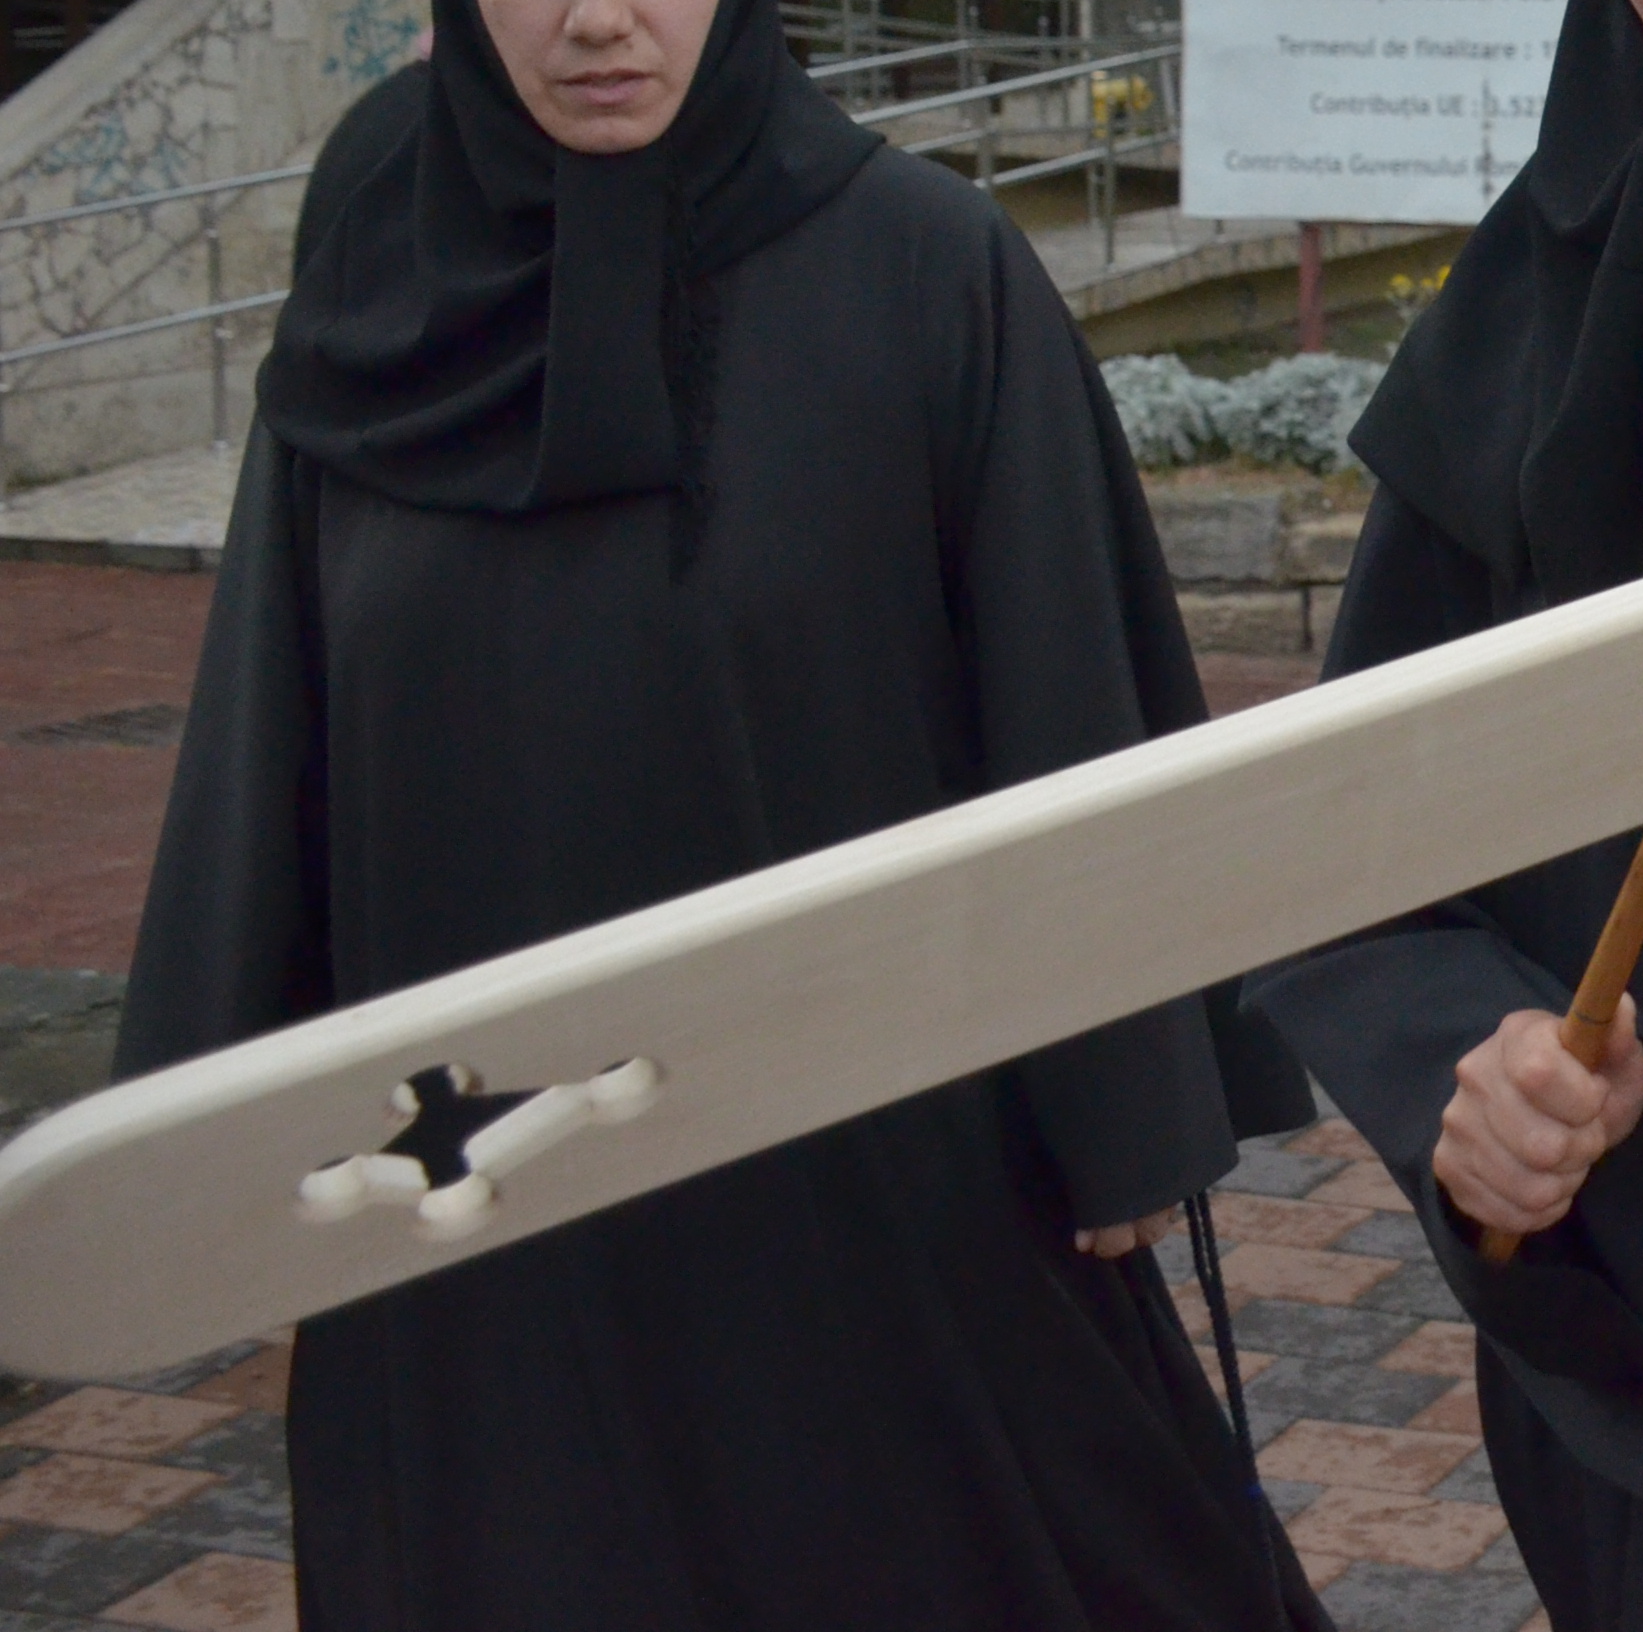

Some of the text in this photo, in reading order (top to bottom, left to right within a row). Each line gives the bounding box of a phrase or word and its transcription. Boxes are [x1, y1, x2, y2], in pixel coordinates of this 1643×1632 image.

[1277, 33, 1376, 58] Termenul
[1382, 34, 1409, 59] de
[1437, 93, 1464, 118] UE
